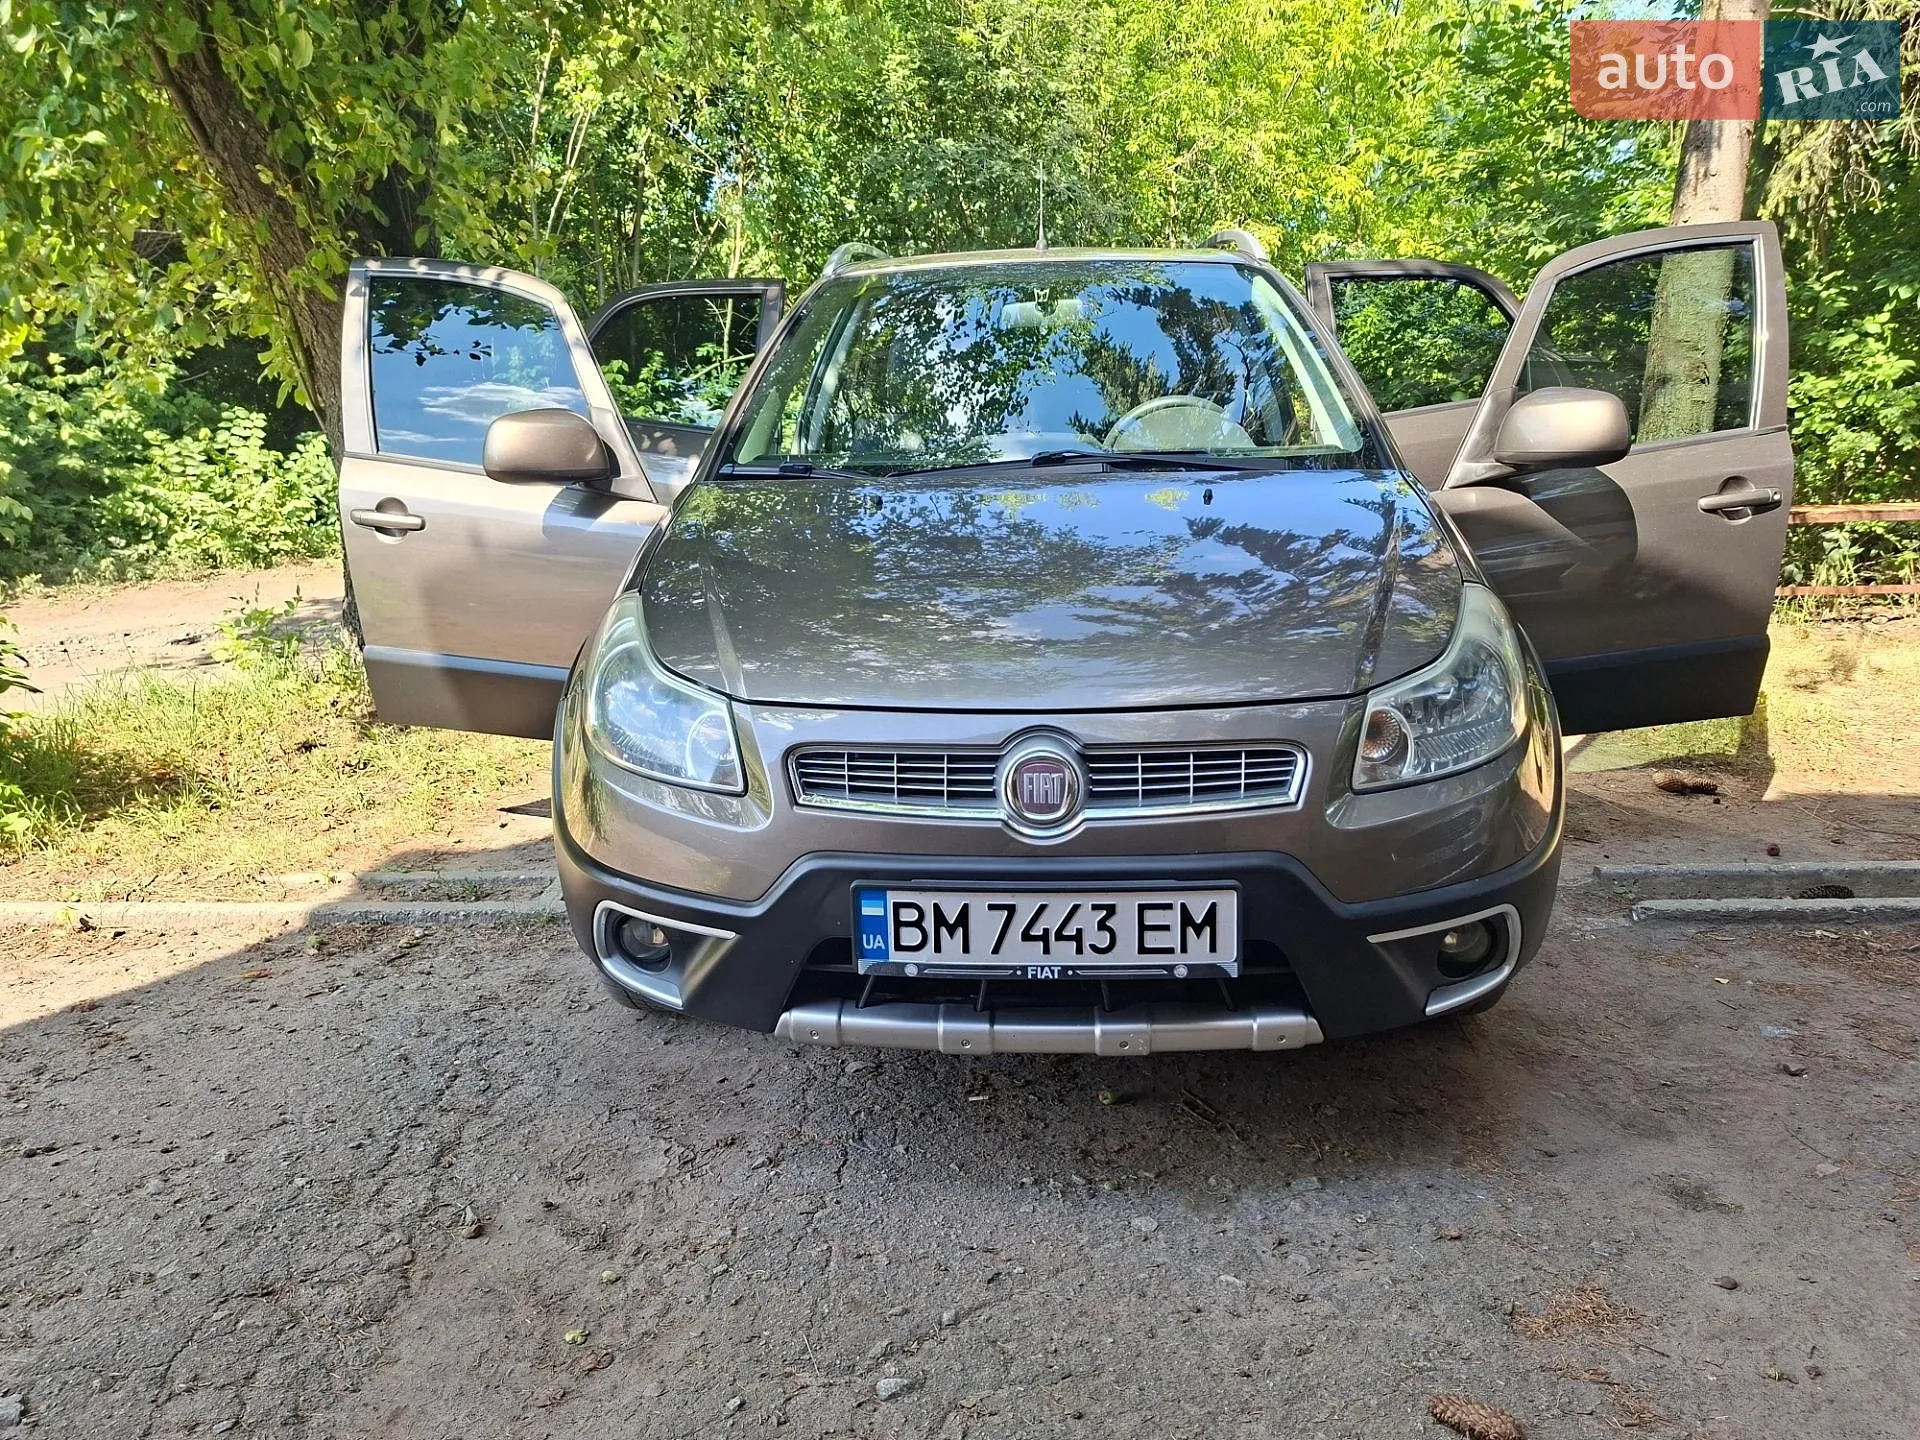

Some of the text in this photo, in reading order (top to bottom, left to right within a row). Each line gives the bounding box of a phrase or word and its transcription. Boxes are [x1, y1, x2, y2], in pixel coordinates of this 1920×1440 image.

[1023, 773, 1064, 804] FIAT
[892, 901, 1217, 955] BM 7443 EM
[862, 933, 885, 950] UA
[1027, 966, 1061, 979] FIAT
